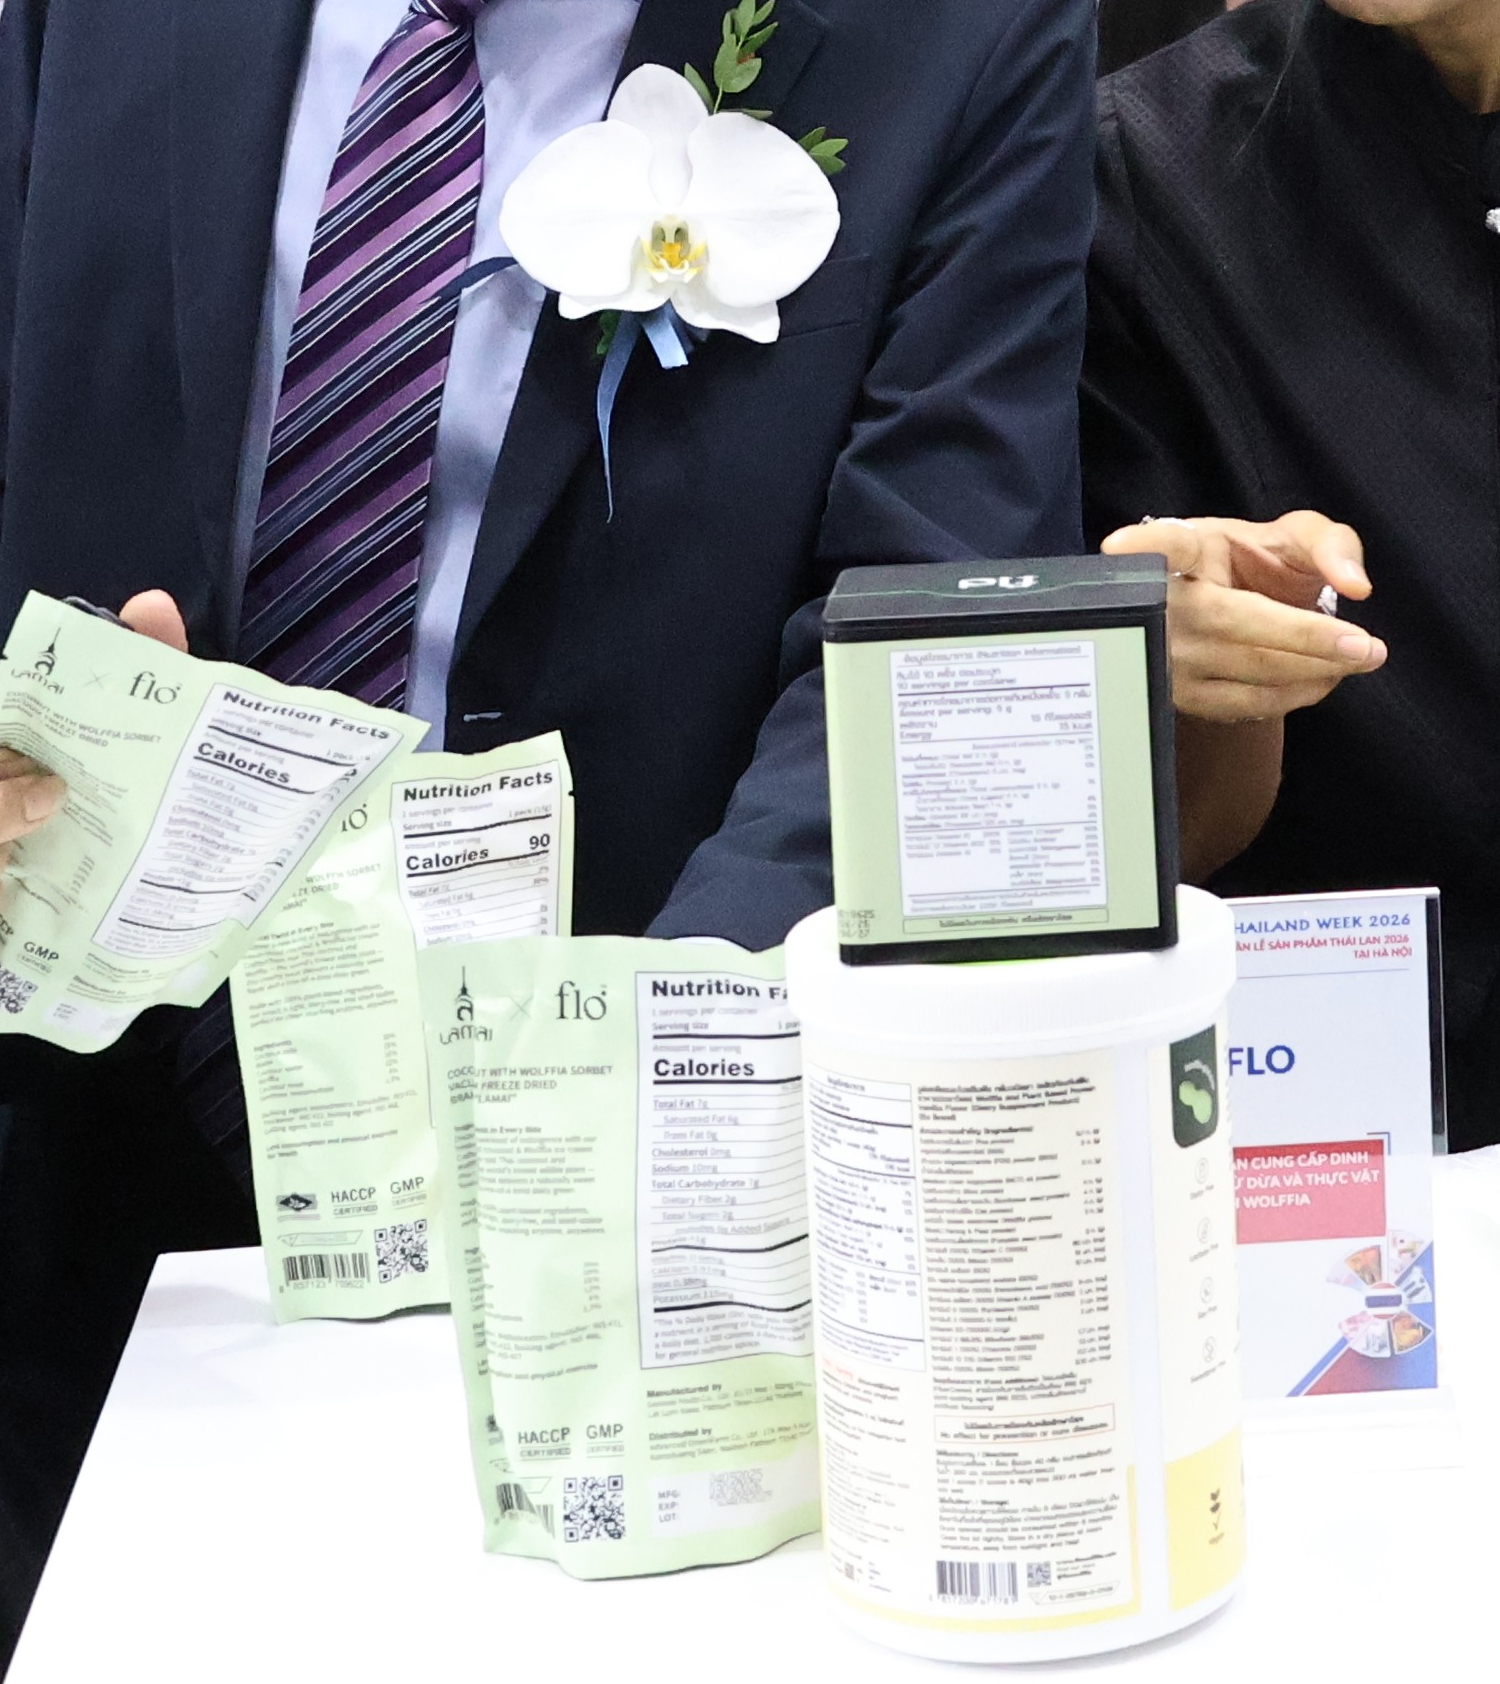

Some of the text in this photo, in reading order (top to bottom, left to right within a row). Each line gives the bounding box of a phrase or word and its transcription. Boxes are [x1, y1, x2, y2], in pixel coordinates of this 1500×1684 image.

[223, 690, 390, 740] Nutrition Facts
[198, 742, 290, 784] Calories
[404, 770, 553, 802] Nutrition Facts
[529, 834, 550, 850] 90
[406, 848, 489, 870] Calories
[1235, 914, 1411, 933] HAILAND WEEK 2026
[23, 941, 60, 962] GMP
[652, 979, 760, 998] Nutrition
[654, 1058, 755, 1077] Calories
[1228, 1045, 1296, 1076] FLO
[1245, 1150, 1368, 1170] CUNG CẤP DINH
[390, 1177, 425, 1195] GMP
[1246, 1167, 1380, 1189] DỪA VÀ THỰC VẬT
[331, 1187, 376, 1203] HACCP
[1243, 1193, 1311, 1210] WOLFFIA
[518, 1424, 624, 1444] HACCP GMP
